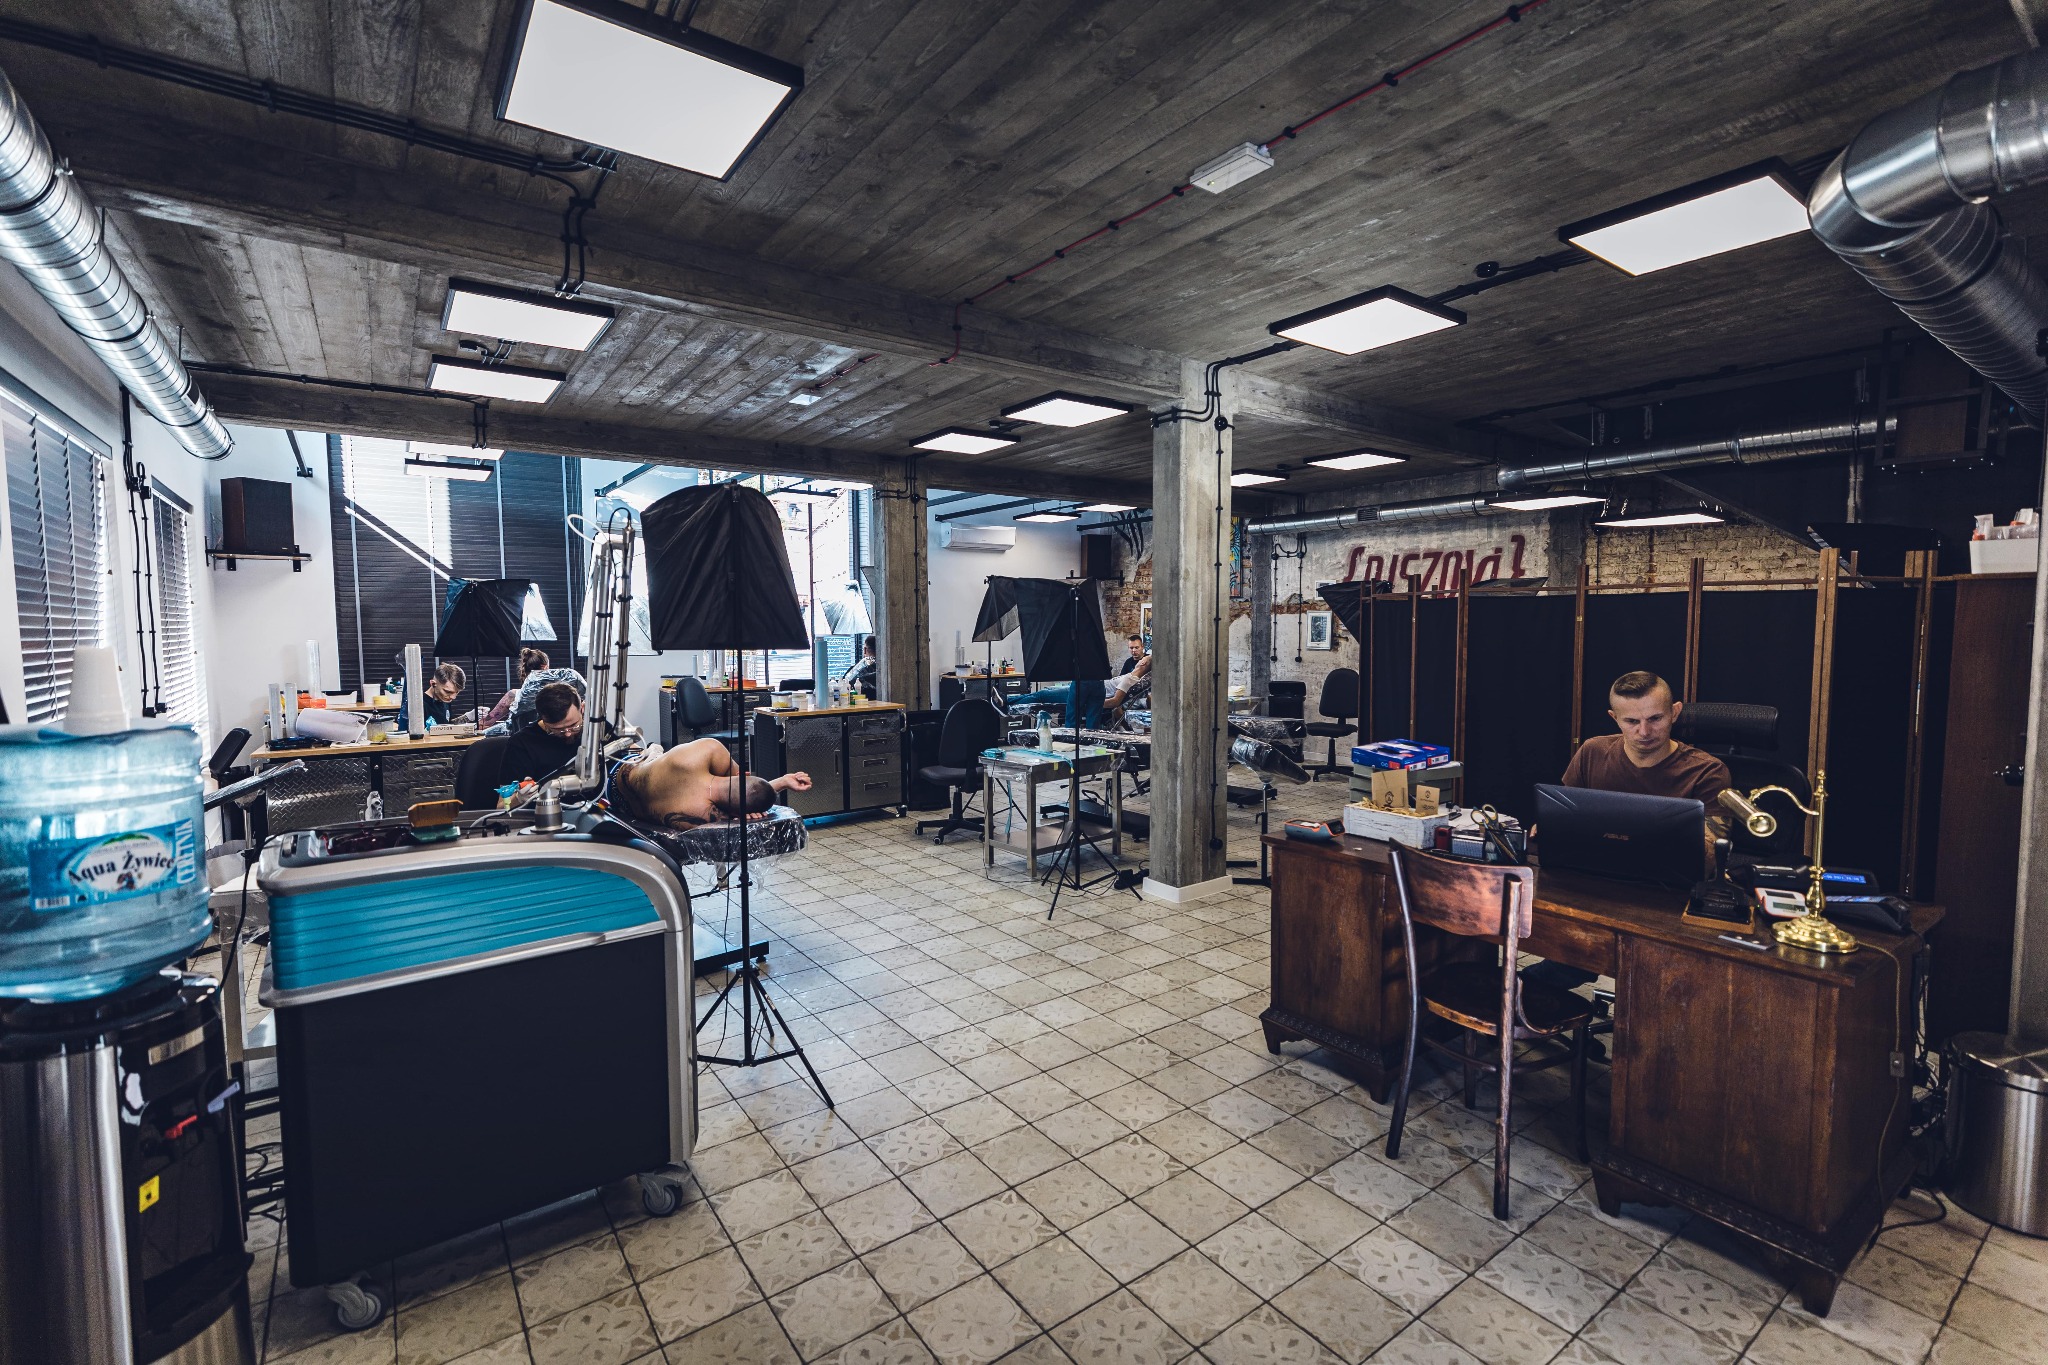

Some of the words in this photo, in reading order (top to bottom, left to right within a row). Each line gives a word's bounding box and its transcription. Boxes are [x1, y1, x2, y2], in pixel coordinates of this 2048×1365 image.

[1602, 832, 1630, 841] ASUS
[68, 860, 116, 884] Aqua
[122, 851, 175, 872] Żywiec
